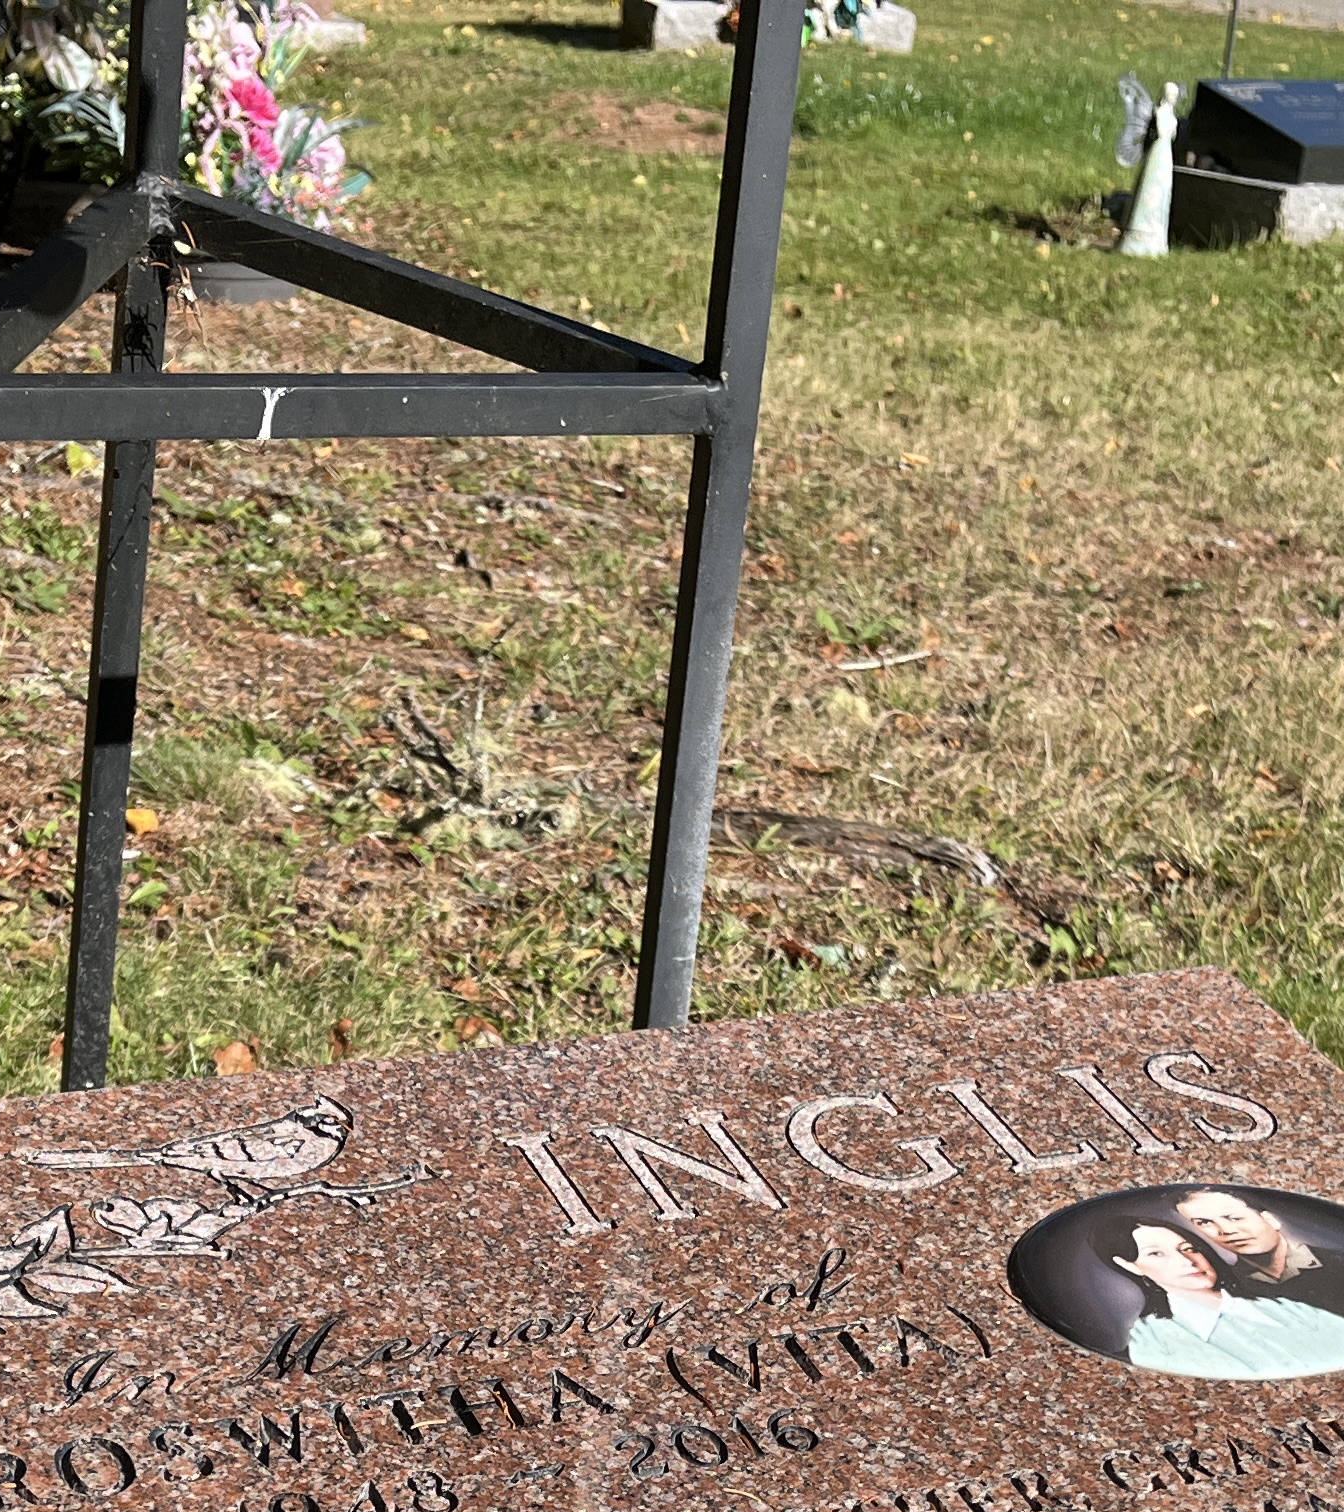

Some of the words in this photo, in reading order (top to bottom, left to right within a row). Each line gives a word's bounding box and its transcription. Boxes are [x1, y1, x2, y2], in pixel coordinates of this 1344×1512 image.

[499, 1050, 1278, 1236] INGLIS
[38, 1347, 216, 1416] In
[231, 1297, 694, 1387] Memory
[735, 1246, 858, 1314] of
[665, 1303, 992, 1416] (VITA)
[610, 1407, 820, 1482] 2016
